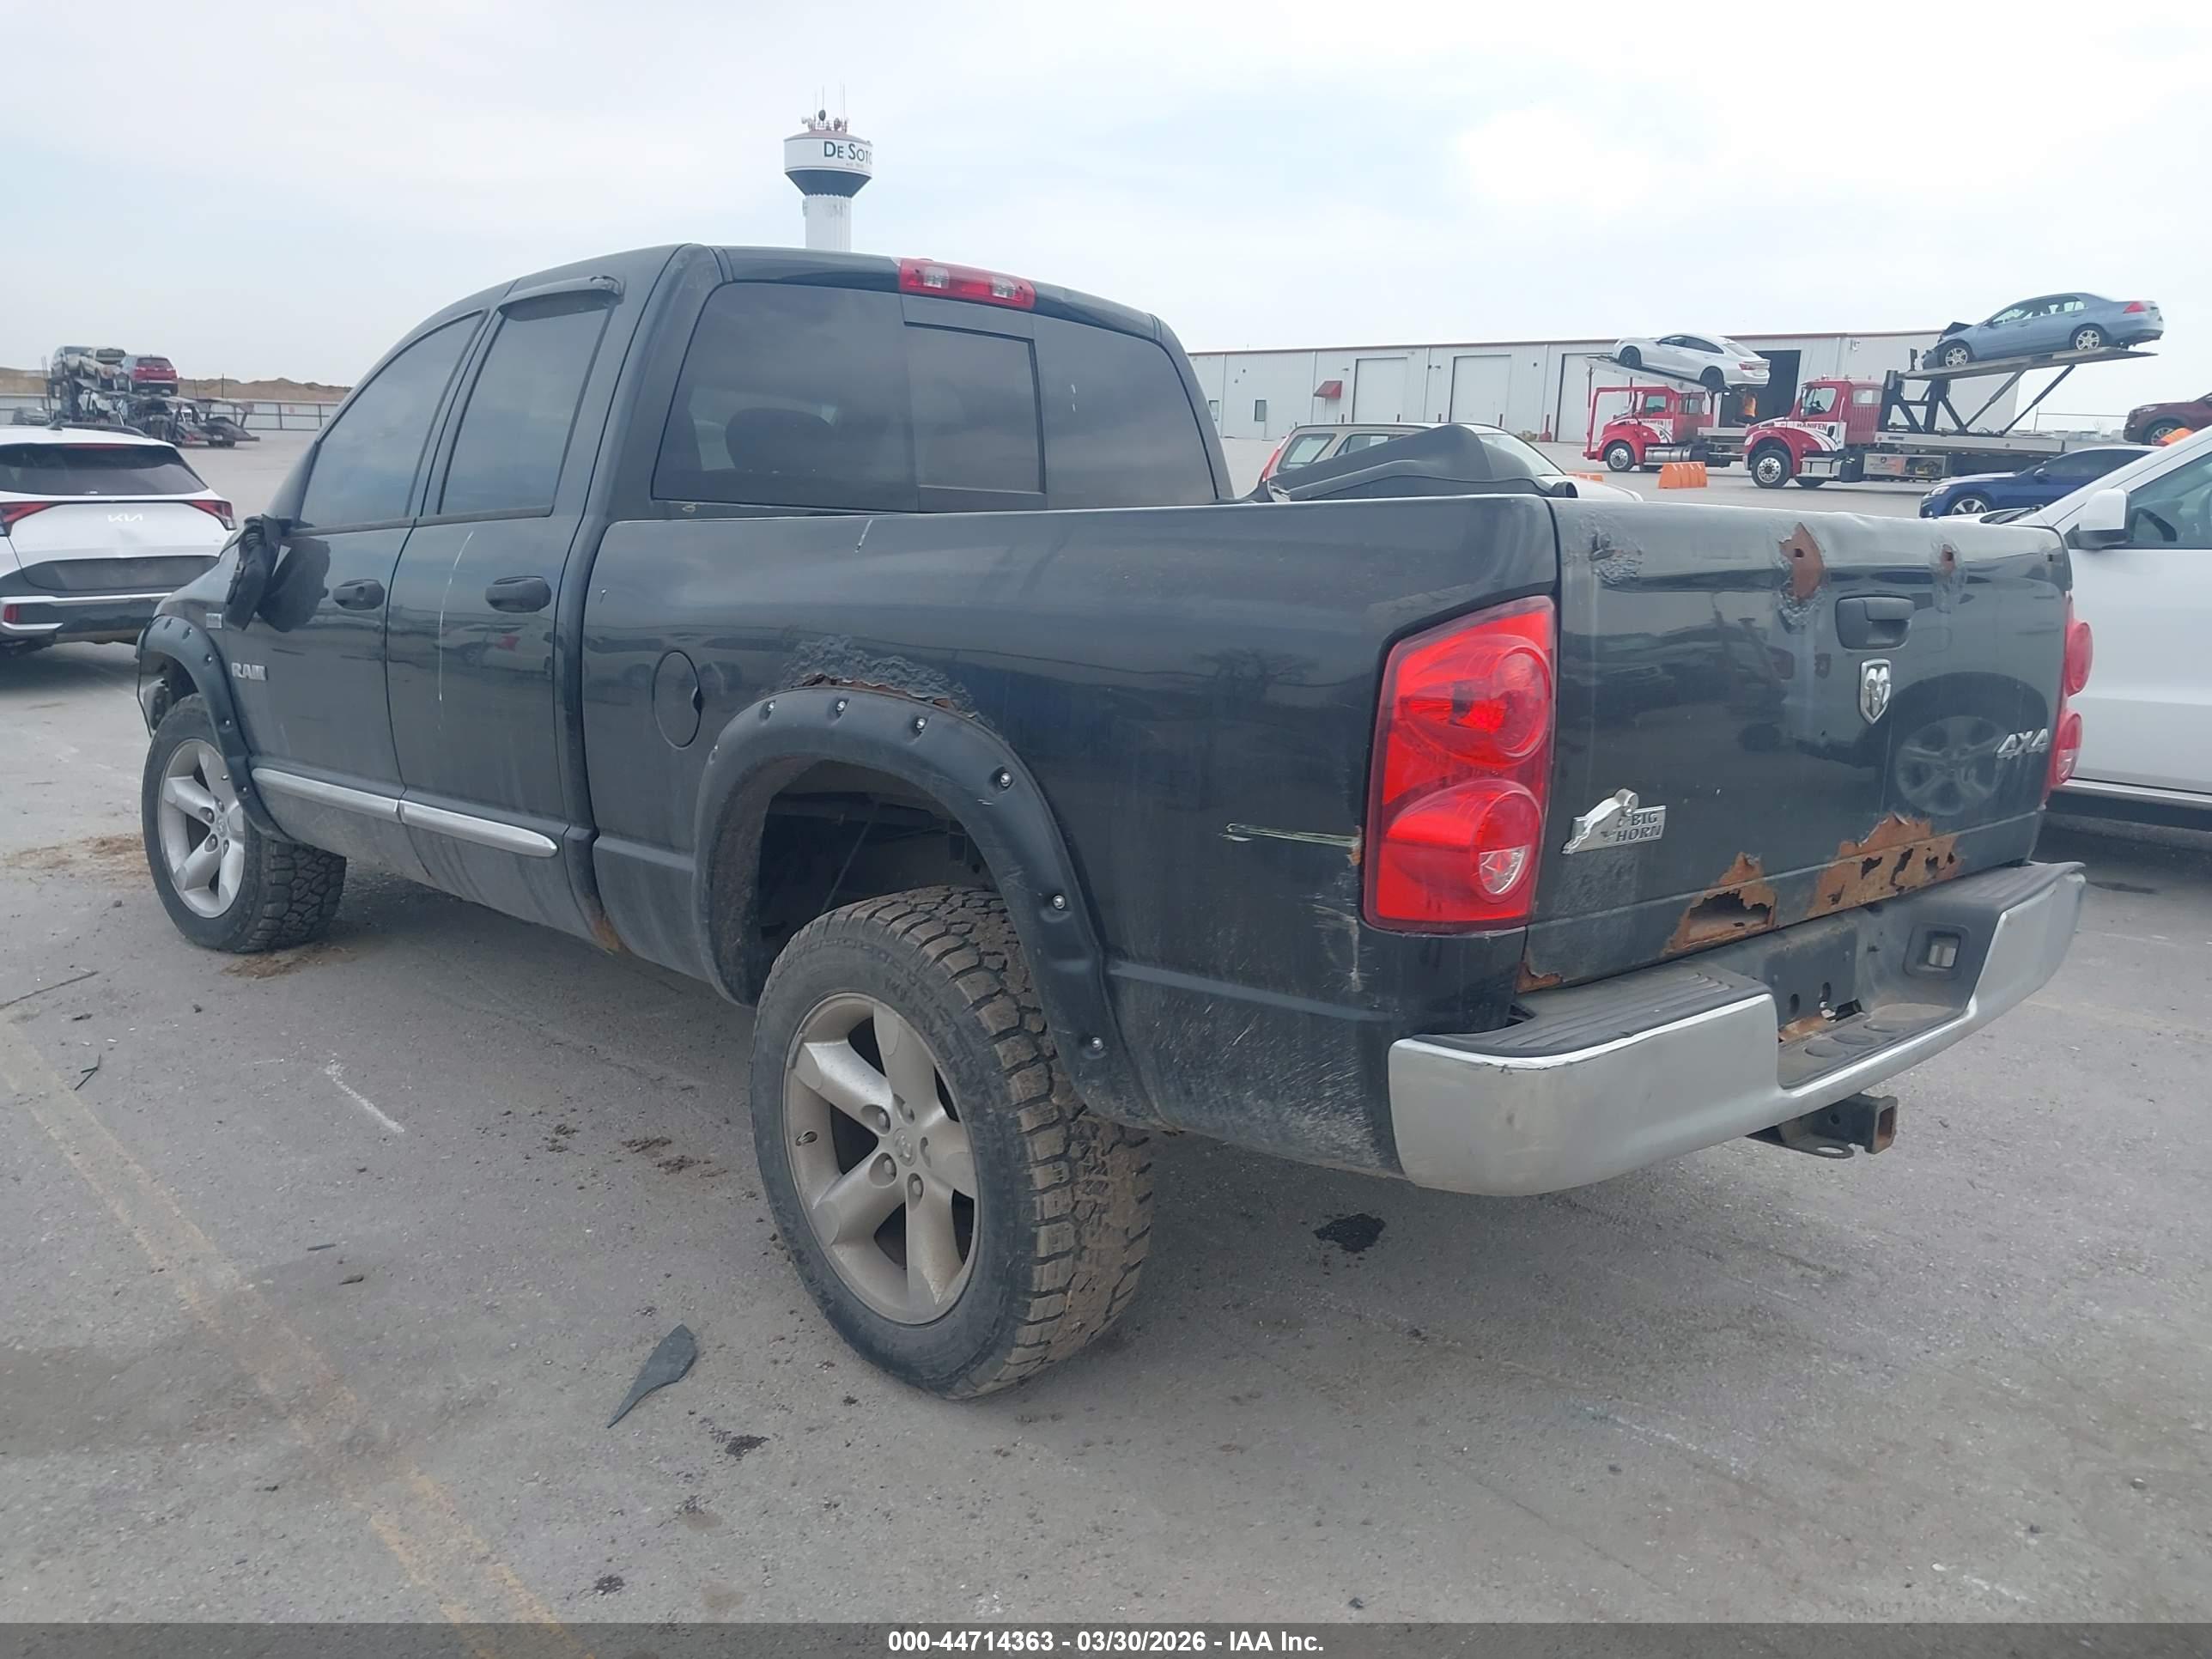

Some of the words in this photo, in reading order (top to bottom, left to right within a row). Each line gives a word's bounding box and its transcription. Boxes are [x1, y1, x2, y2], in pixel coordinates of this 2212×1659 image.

[107, 513, 143, 522] KIA
[1631, 811, 1658, 826] BIG
[1615, 824, 1662, 842] HORN
